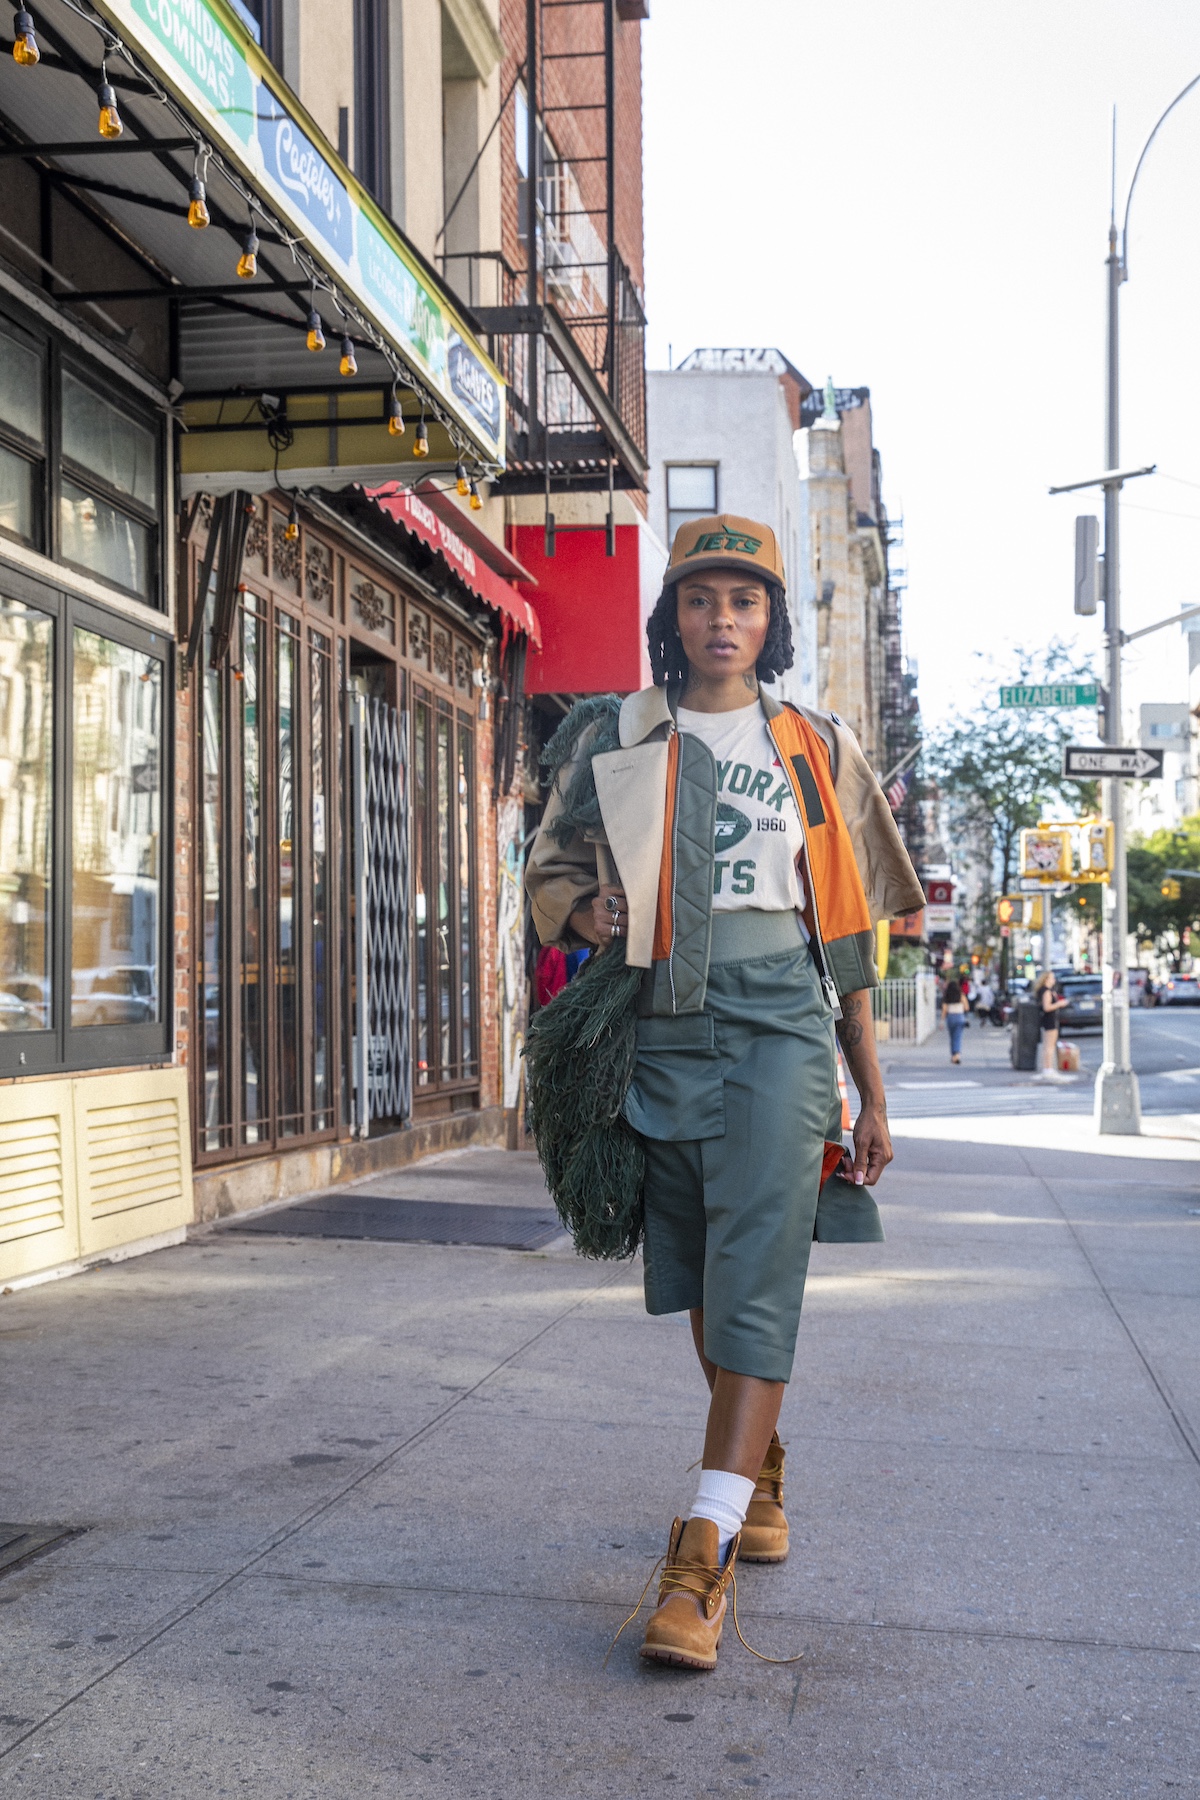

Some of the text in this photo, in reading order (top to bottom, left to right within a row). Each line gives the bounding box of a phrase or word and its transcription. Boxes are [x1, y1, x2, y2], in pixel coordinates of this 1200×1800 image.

[456, 350, 494, 408] AGAVES
[685, 524, 763, 558] JETS
[1002, 686, 1077, 706] ELIZABETH
[1078, 756, 1150, 769] ONE WAY
[716, 760, 793, 814] YORK
[757, 818, 786, 832] 1960
